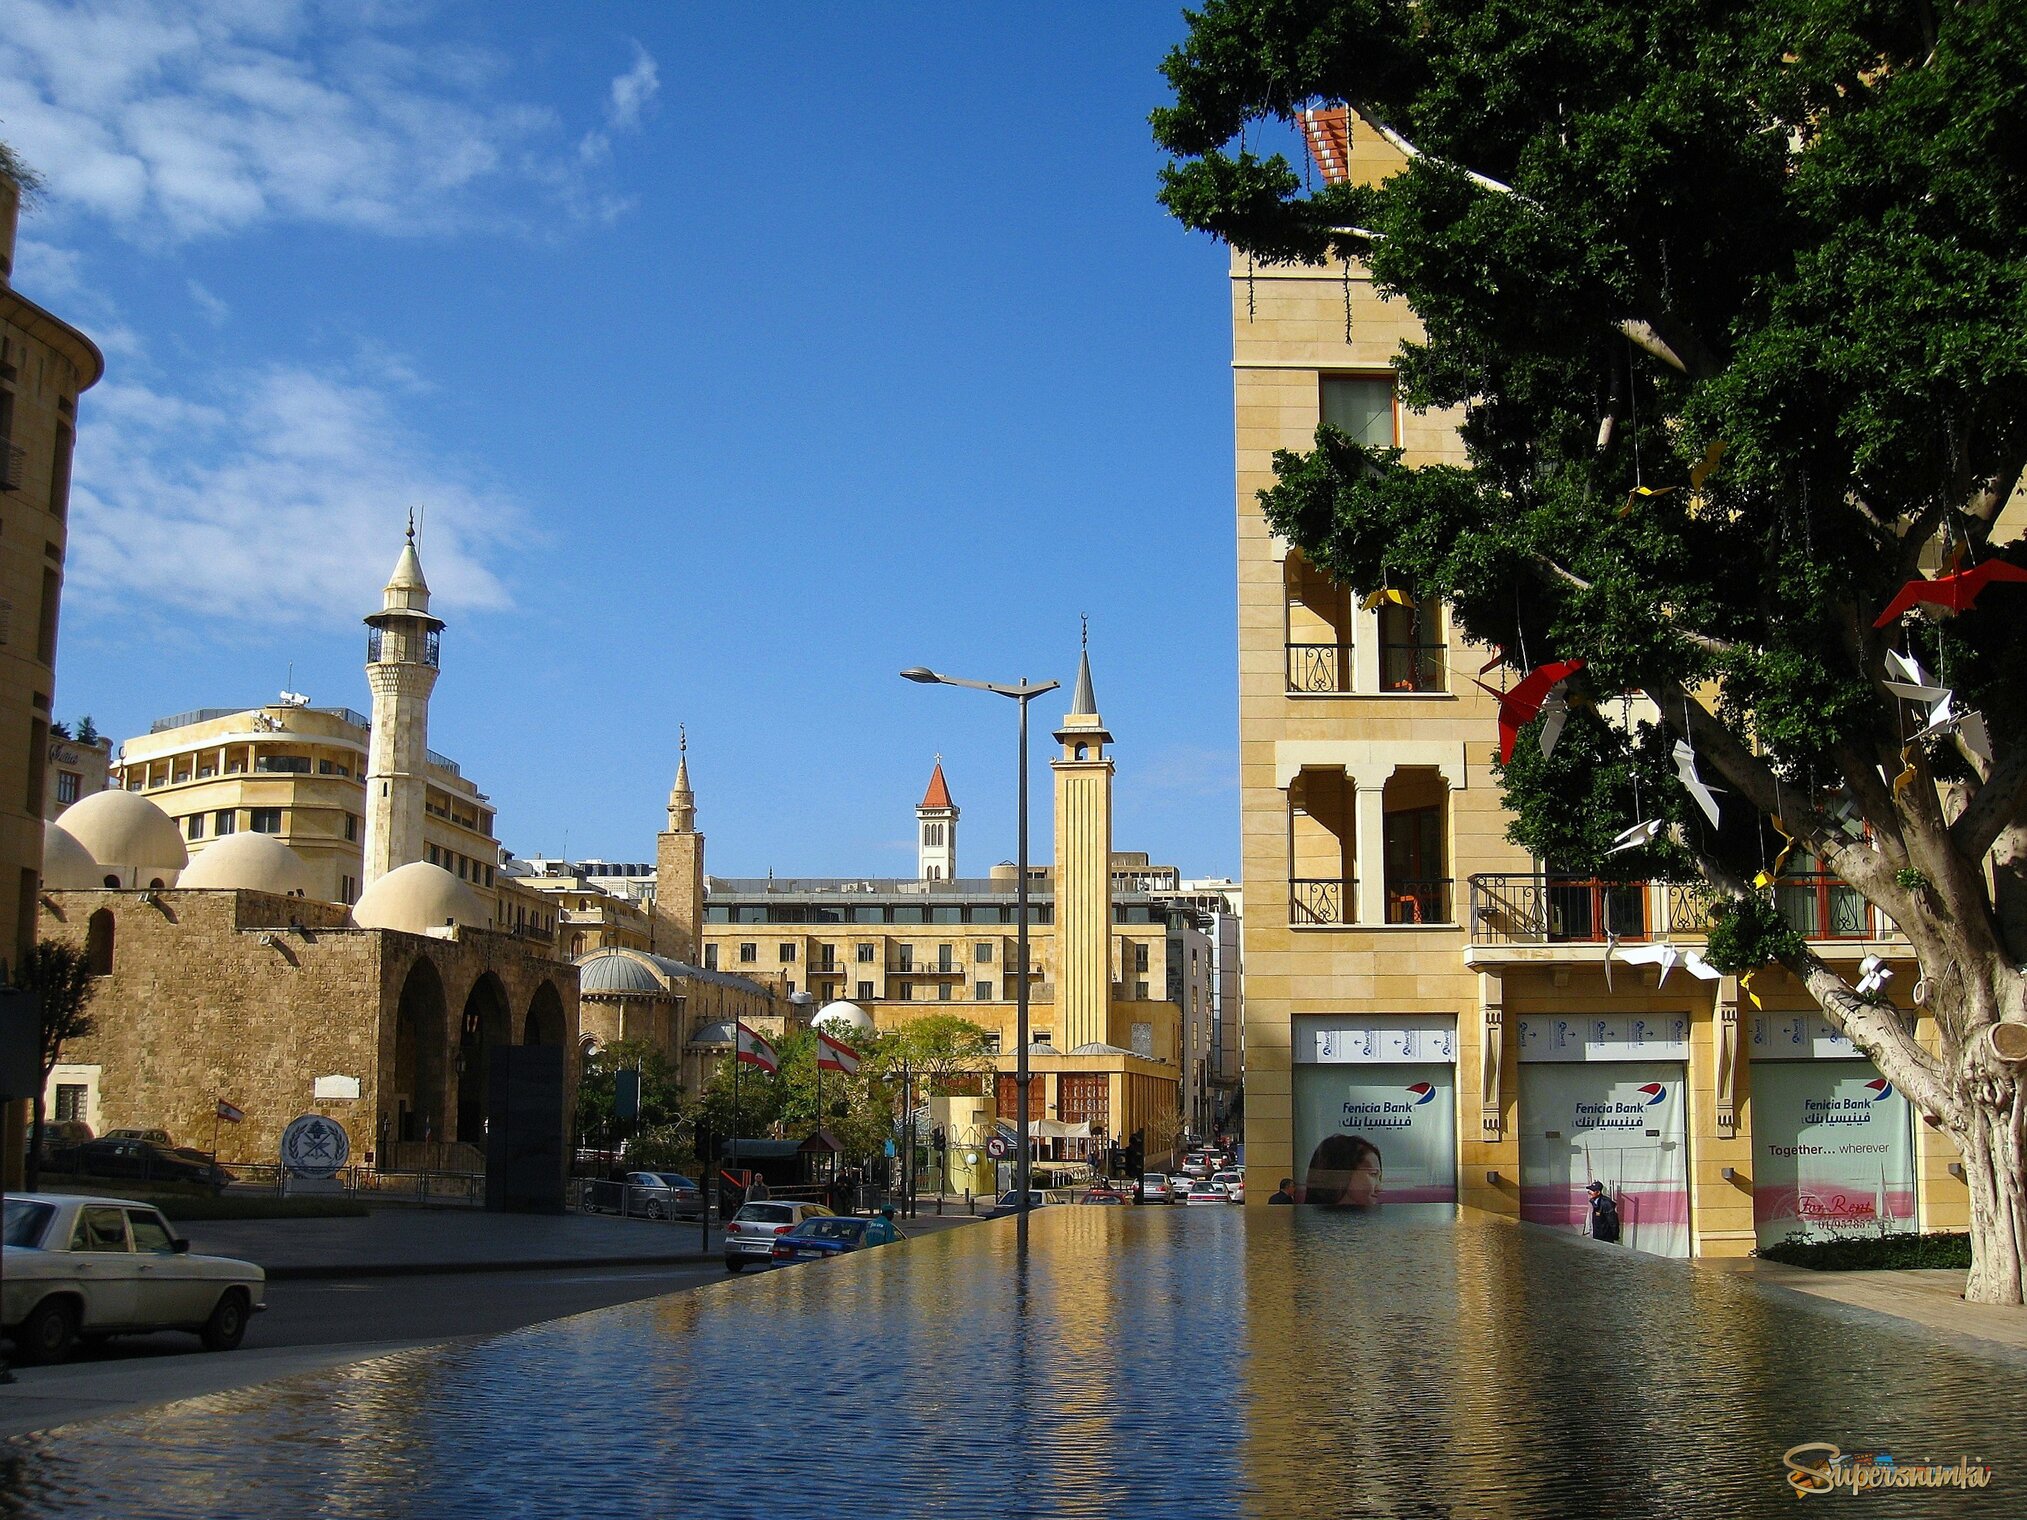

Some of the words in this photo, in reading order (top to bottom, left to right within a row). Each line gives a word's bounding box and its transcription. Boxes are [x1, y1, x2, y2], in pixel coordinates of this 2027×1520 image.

[1343, 1102, 1381, 1113] Fenicia
[1383, 1101, 1412, 1113] Bank
[1576, 1102, 1613, 1114] Fenicia
[1615, 1102, 1644, 1113] Bank
[1805, 1099, 1841, 1110] Fenicia
[1843, 1098, 1871, 1109] Bank
[1342, 1116, 1362, 1131] بنك
[1364, 1115, 1412, 1131] فينيسيا
[1575, 1117, 1595, 1131] بنك
[1596, 1116, 1643, 1131] فينيسيا
[1804, 1112, 1824, 1127] بنك
[1826, 1111, 1871, 1127] فينيسيا
[1768, 1144, 1836, 1157] Together...
[1839, 1143, 1890, 1154] wherever
[1797, 1195, 1824, 1213] For
[1828, 1194, 1873, 1214] Rent
